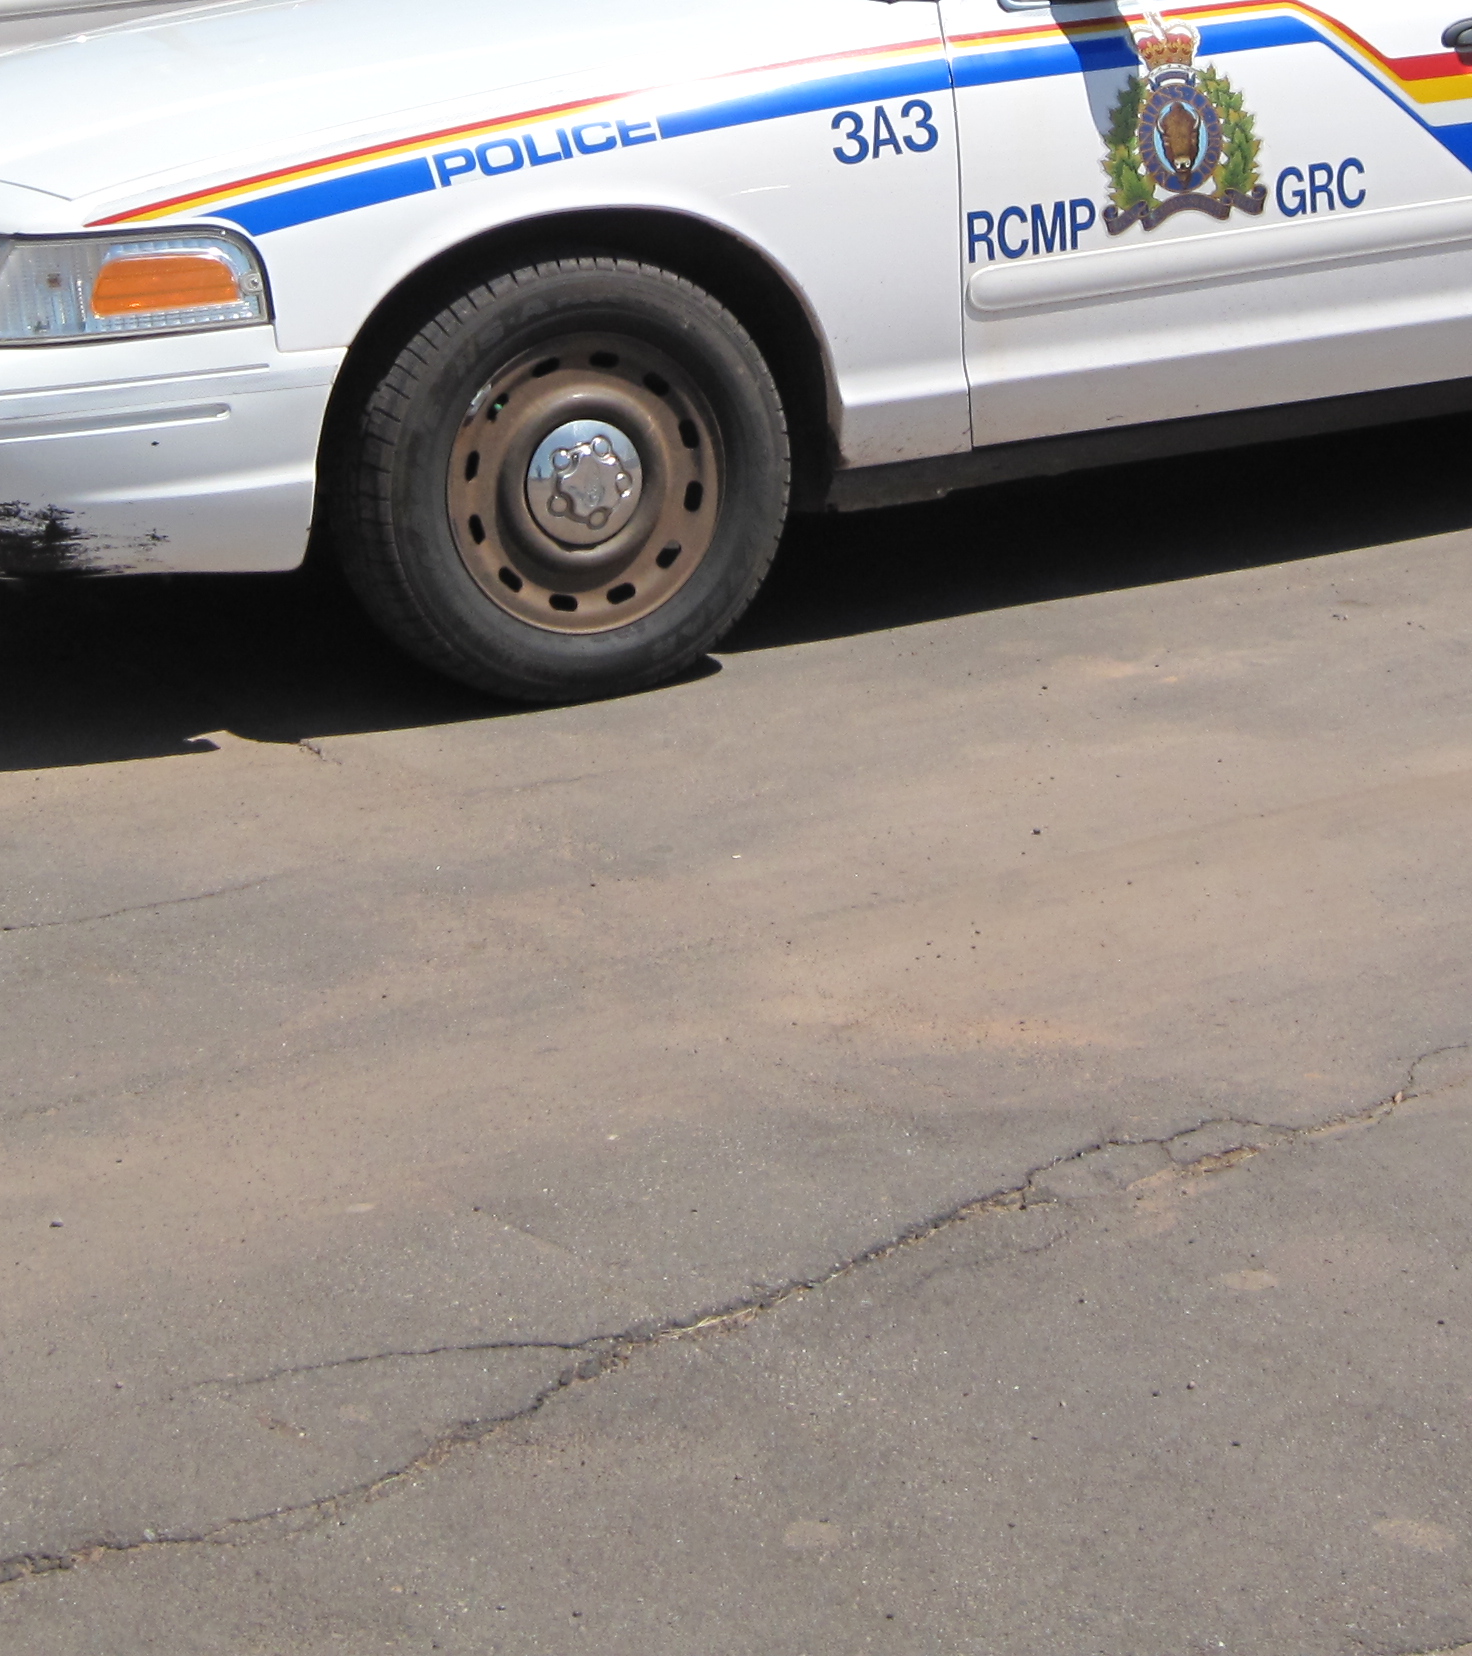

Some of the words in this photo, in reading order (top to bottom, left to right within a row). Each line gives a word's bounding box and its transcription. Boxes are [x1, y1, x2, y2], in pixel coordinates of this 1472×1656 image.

[432, 118, 658, 188] POLICE
[831, 99, 939, 165] 3A3
[966, 196, 1096, 264] RCMP
[1275, 157, 1366, 218] GRC
